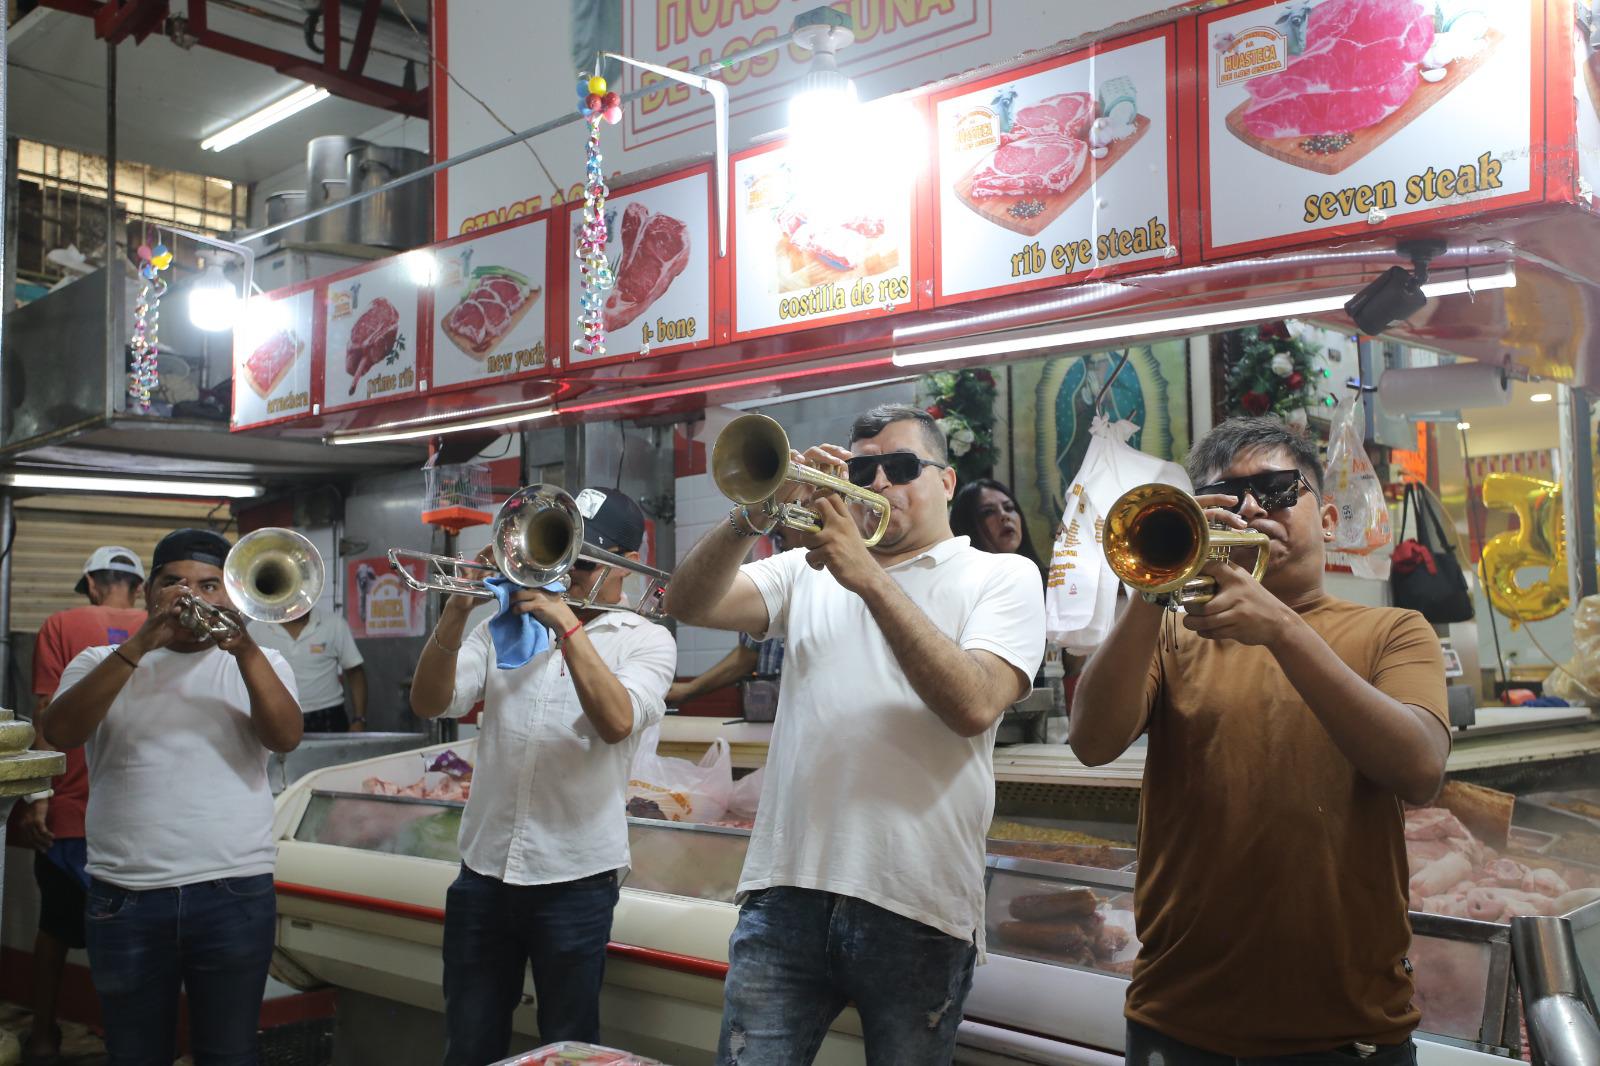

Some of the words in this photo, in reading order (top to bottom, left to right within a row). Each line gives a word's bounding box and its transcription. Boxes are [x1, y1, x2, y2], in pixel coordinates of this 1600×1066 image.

[1224, 44, 1277, 73] HUASTECA
[1303, 180, 1397, 223] seven
[1405, 151, 1503, 205] steak
[1011, 241, 1047, 277] rib
[1051, 239, 1093, 275] eye
[1096, 216, 1167, 261] steak
[779, 283, 847, 320] costilla
[850, 277, 875, 308] de
[879, 276, 910, 302] res
[657, 316, 696, 343] bone
[487, 350, 514, 374] new
[515, 341, 546, 374] york
